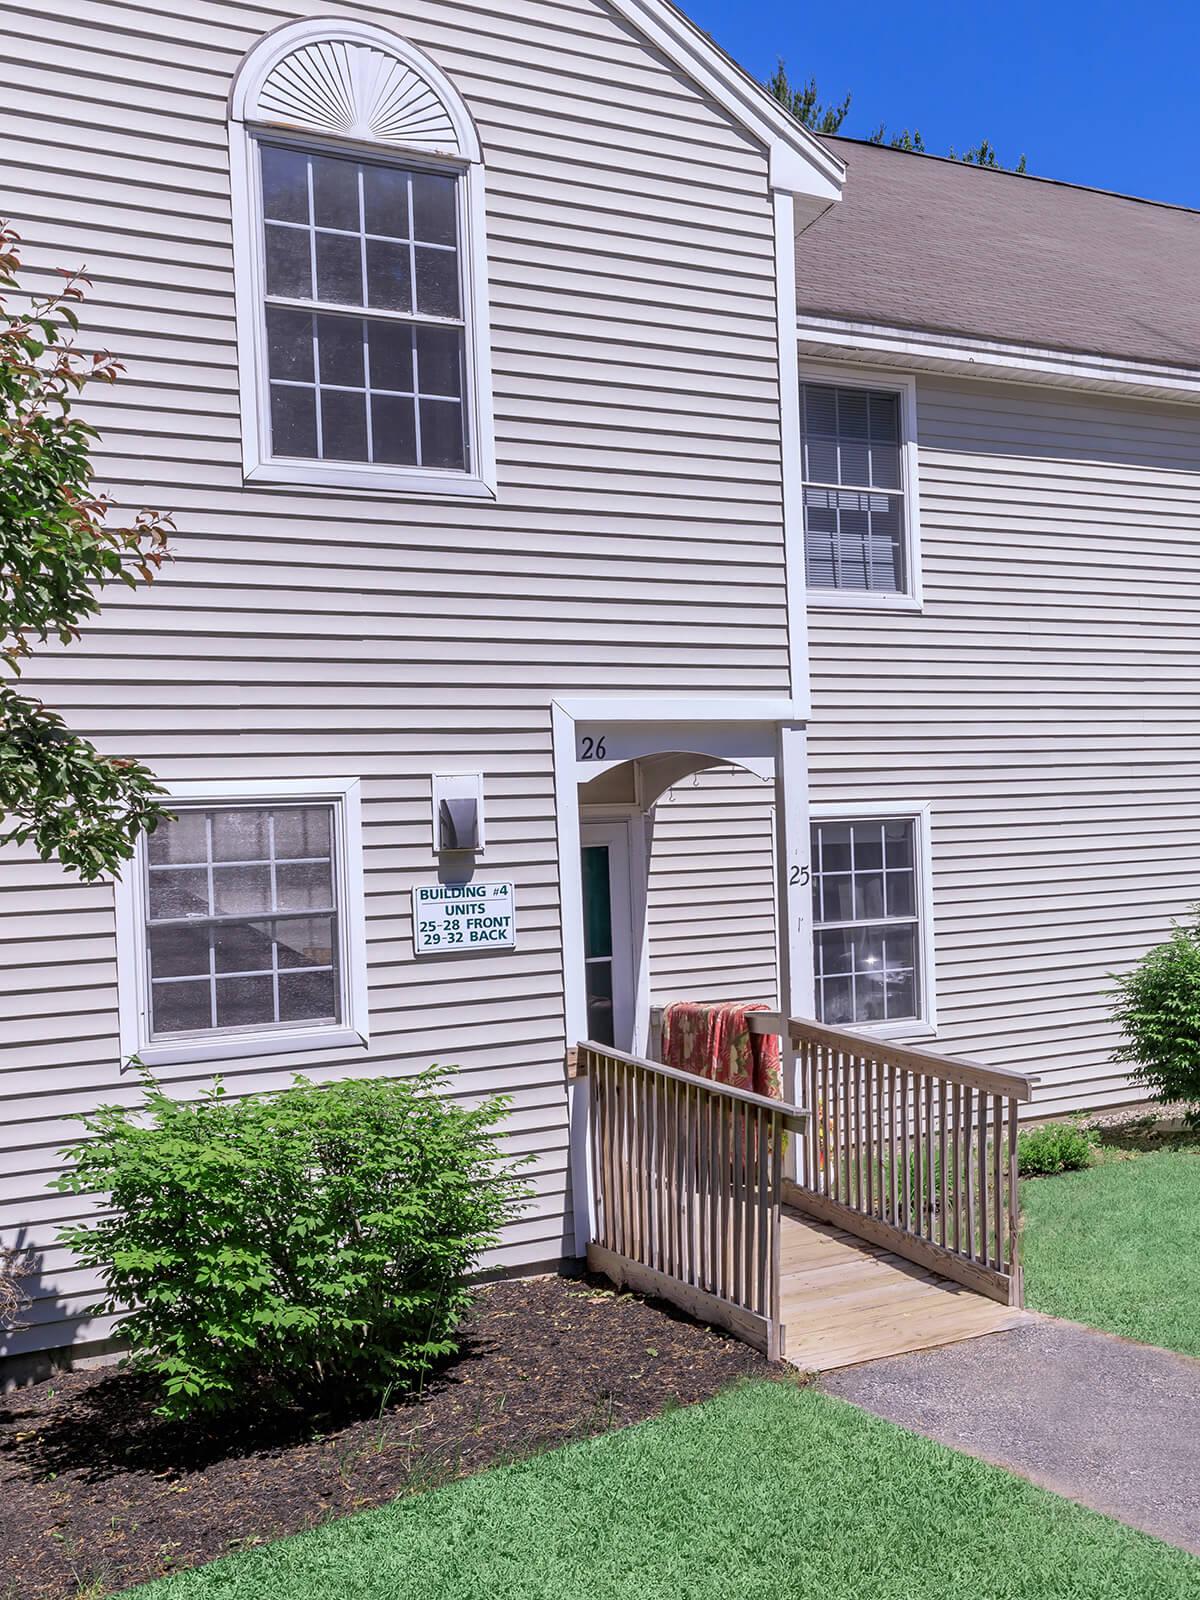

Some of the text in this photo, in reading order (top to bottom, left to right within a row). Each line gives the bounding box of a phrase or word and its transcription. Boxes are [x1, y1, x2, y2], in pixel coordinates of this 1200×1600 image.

[581, 735, 606, 760] 26
[789, 865, 810, 887] 25
[420, 885, 508, 900] BUILDING #4
[445, 903, 485, 916] UNITS
[419, 916, 511, 932] 25-28 FRONT
[423, 929, 507, 945] 29-32 BACK
